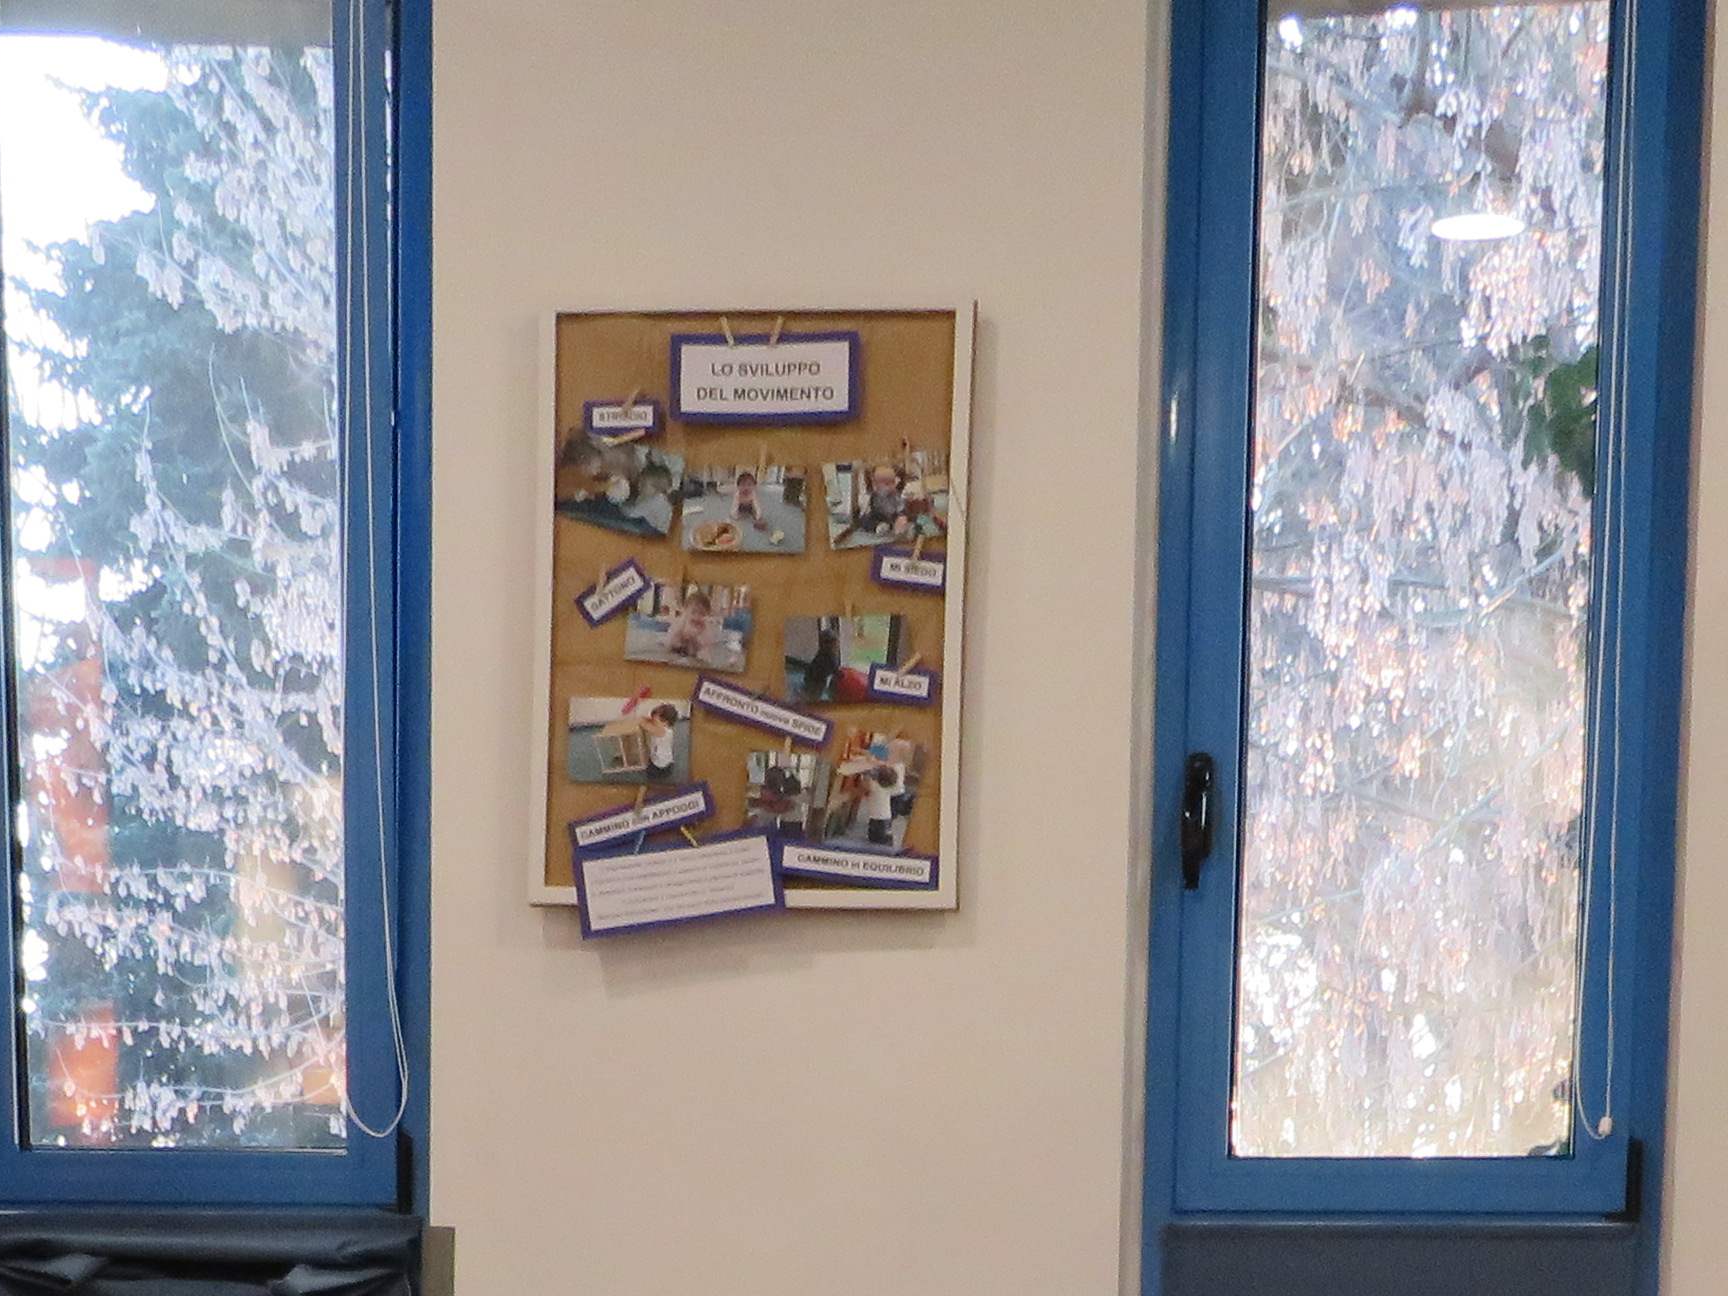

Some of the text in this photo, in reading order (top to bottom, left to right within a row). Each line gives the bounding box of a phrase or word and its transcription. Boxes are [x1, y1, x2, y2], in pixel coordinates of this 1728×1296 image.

[711, 360, 821, 377] LO SVILUPPO
[696, 386, 834, 401] DEL MOVIMENTO
[797, 854, 849, 867] CAMMINO
[862, 862, 925, 876] EQUILIBRIO
